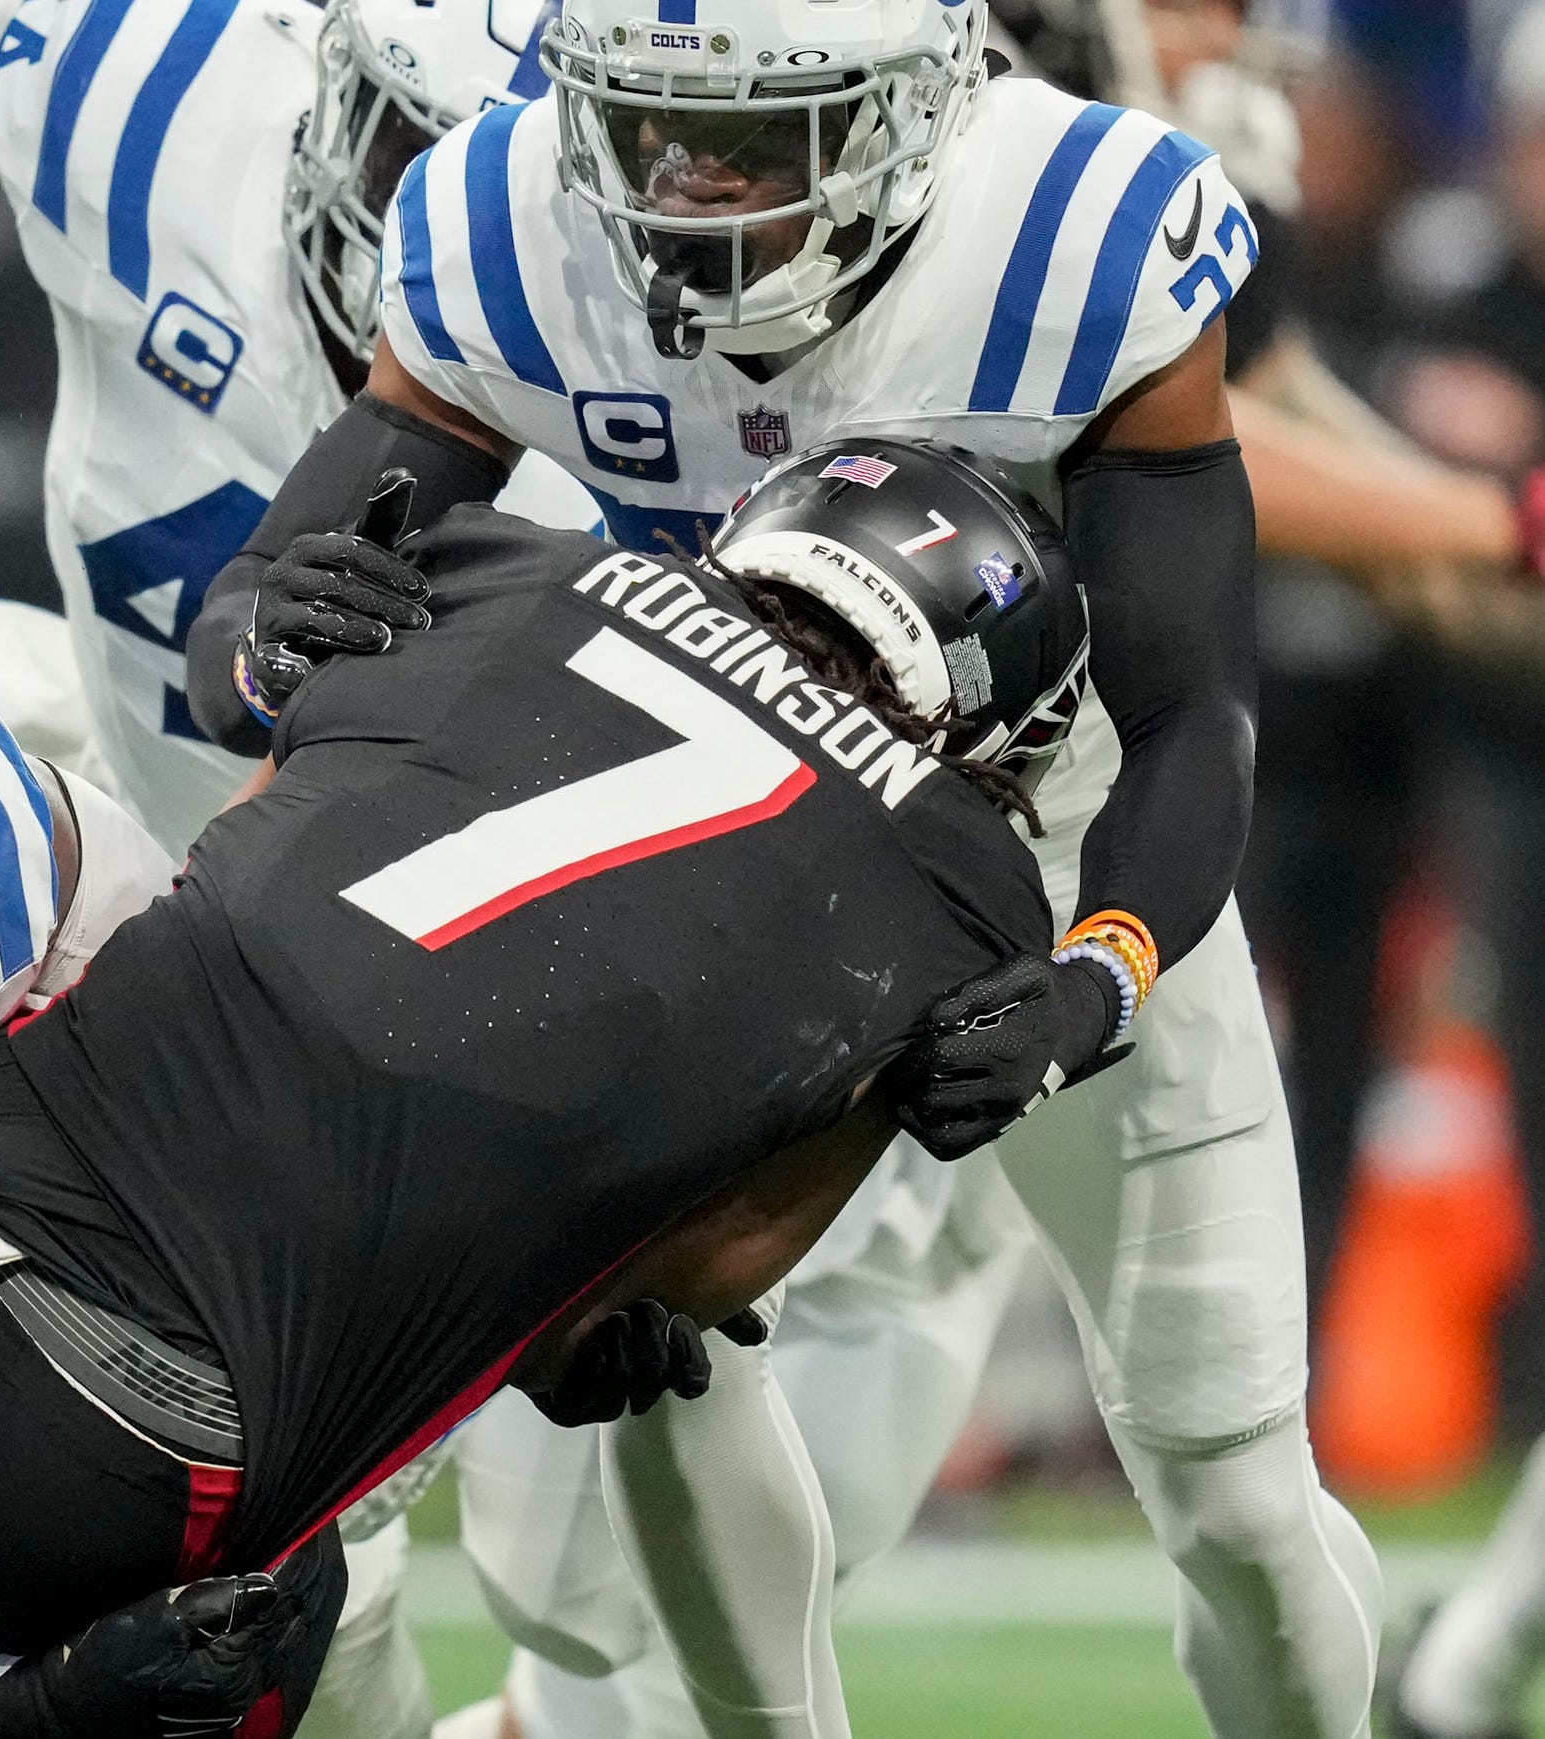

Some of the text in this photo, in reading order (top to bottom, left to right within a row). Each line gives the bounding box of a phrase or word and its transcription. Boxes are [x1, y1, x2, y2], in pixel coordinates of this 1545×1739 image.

[651, 33, 700, 50] COLTS
[150, 303, 234, 390] C
[582, 400, 667, 460] C
[748, 431, 784, 452] NFL
[894, 508, 959, 557] 7
[810, 543, 922, 643] FALCONS
[977, 567, 1006, 607] CHANGE
[572, 550, 942, 811] ROBINSON
[337, 625, 819, 952] 7
